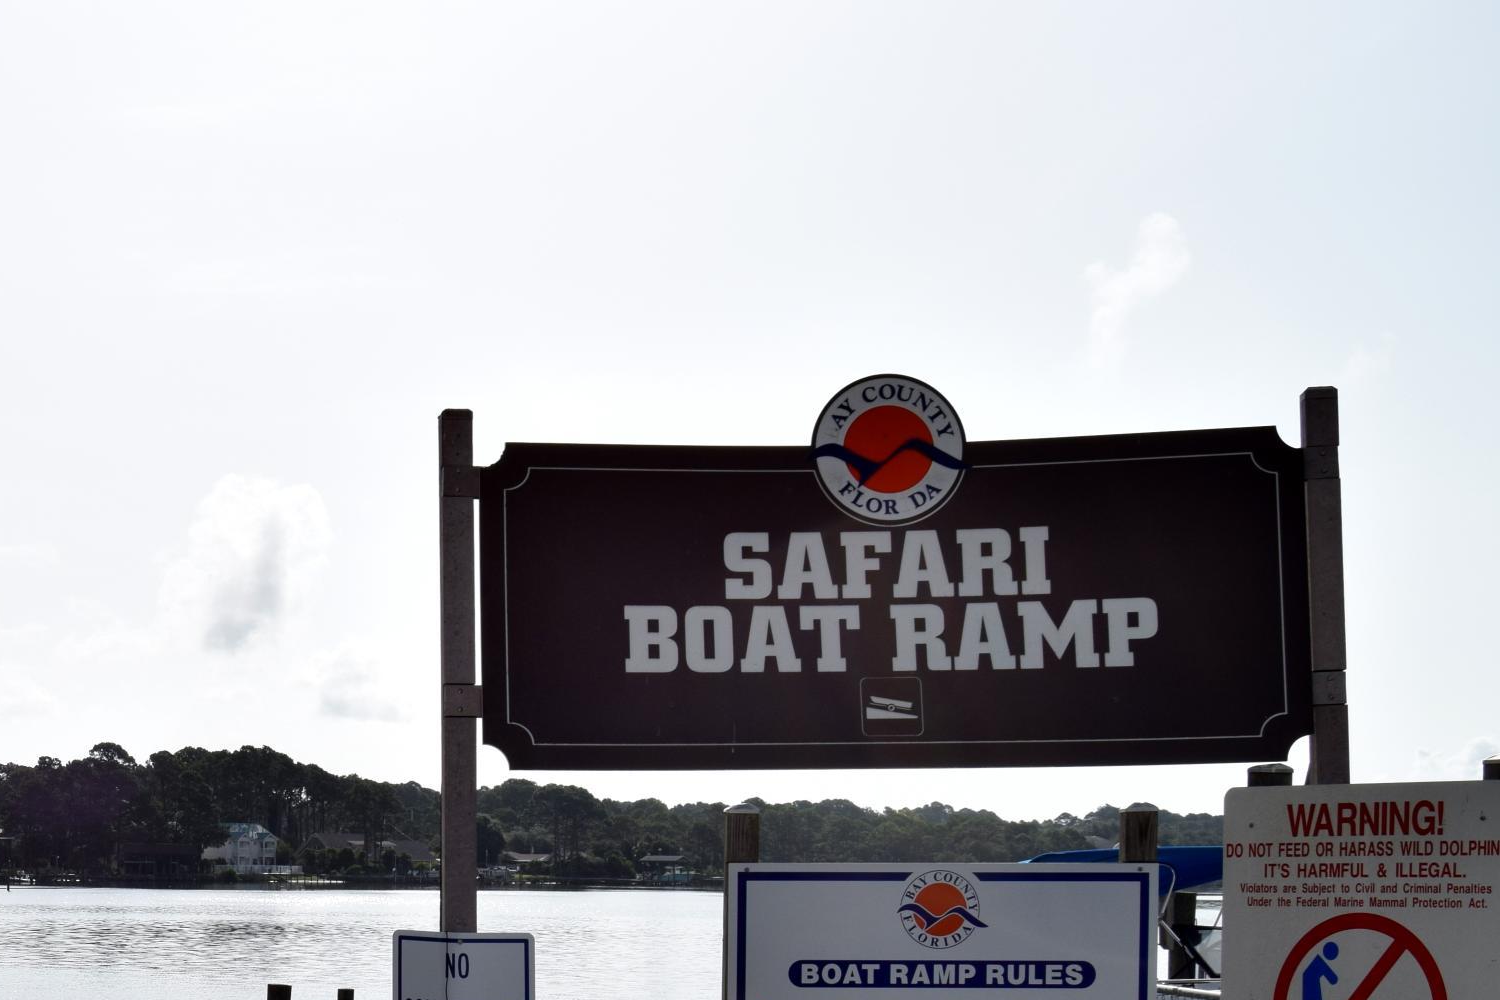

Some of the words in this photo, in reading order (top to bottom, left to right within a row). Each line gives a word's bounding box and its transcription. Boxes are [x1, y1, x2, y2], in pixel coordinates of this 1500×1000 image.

[862, 384, 954, 438] COUNTY
[723, 526, 1052, 601] SAFARI
[624, 605, 860, 672] BOAT
[890, 597, 1159, 673] RAMP
[1287, 800, 1444, 837] WARNING!
[1227, 843, 1243, 858] DO
[1249, 843, 1273, 857] NOT
[1279, 843, 1309, 857] FEED
[1316, 842, 1333, 857] OR
[1340, 841, 1393, 856] HARASS
[1400, 841, 1433, 856] WILD
[1265, 863, 1290, 878] IT'S
[1298, 863, 1368, 878] HARMFUL
[1377, 863, 1386, 877] &
[1396, 862, 1466, 878] ILLEGAL.
[905, 876, 927, 899] BAY
[934, 872, 977, 910] COUNTY
[1241, 883, 1277, 893] Violators
[1283, 885, 1297, 893] are
[1302, 883, 1335, 896] Subject
[1341, 884, 1350, 893] to
[1356, 883, 1375, 893] Civil
[1381, 883, 1397, 893] and
[1403, 883, 1441, 893] Criminal
[1447, 883, 1492, 894] Penalties
[1247, 896, 1272, 907] Under
[1278, 897, 1291, 907] the
[1297, 897, 1329, 907] Federal
[1334, 897, 1364, 907] Marine
[1370, 897, 1407, 907] Mammal
[1413, 897, 1462, 908] Protection
[1469, 898, 1487, 908] Act.
[903, 915, 971, 947] FLORIDA
[446, 953, 469, 978] NO
[802, 964, 880, 984] BOAT
[890, 964, 976, 984] RAMP
[986, 964, 1083, 985] RULES
